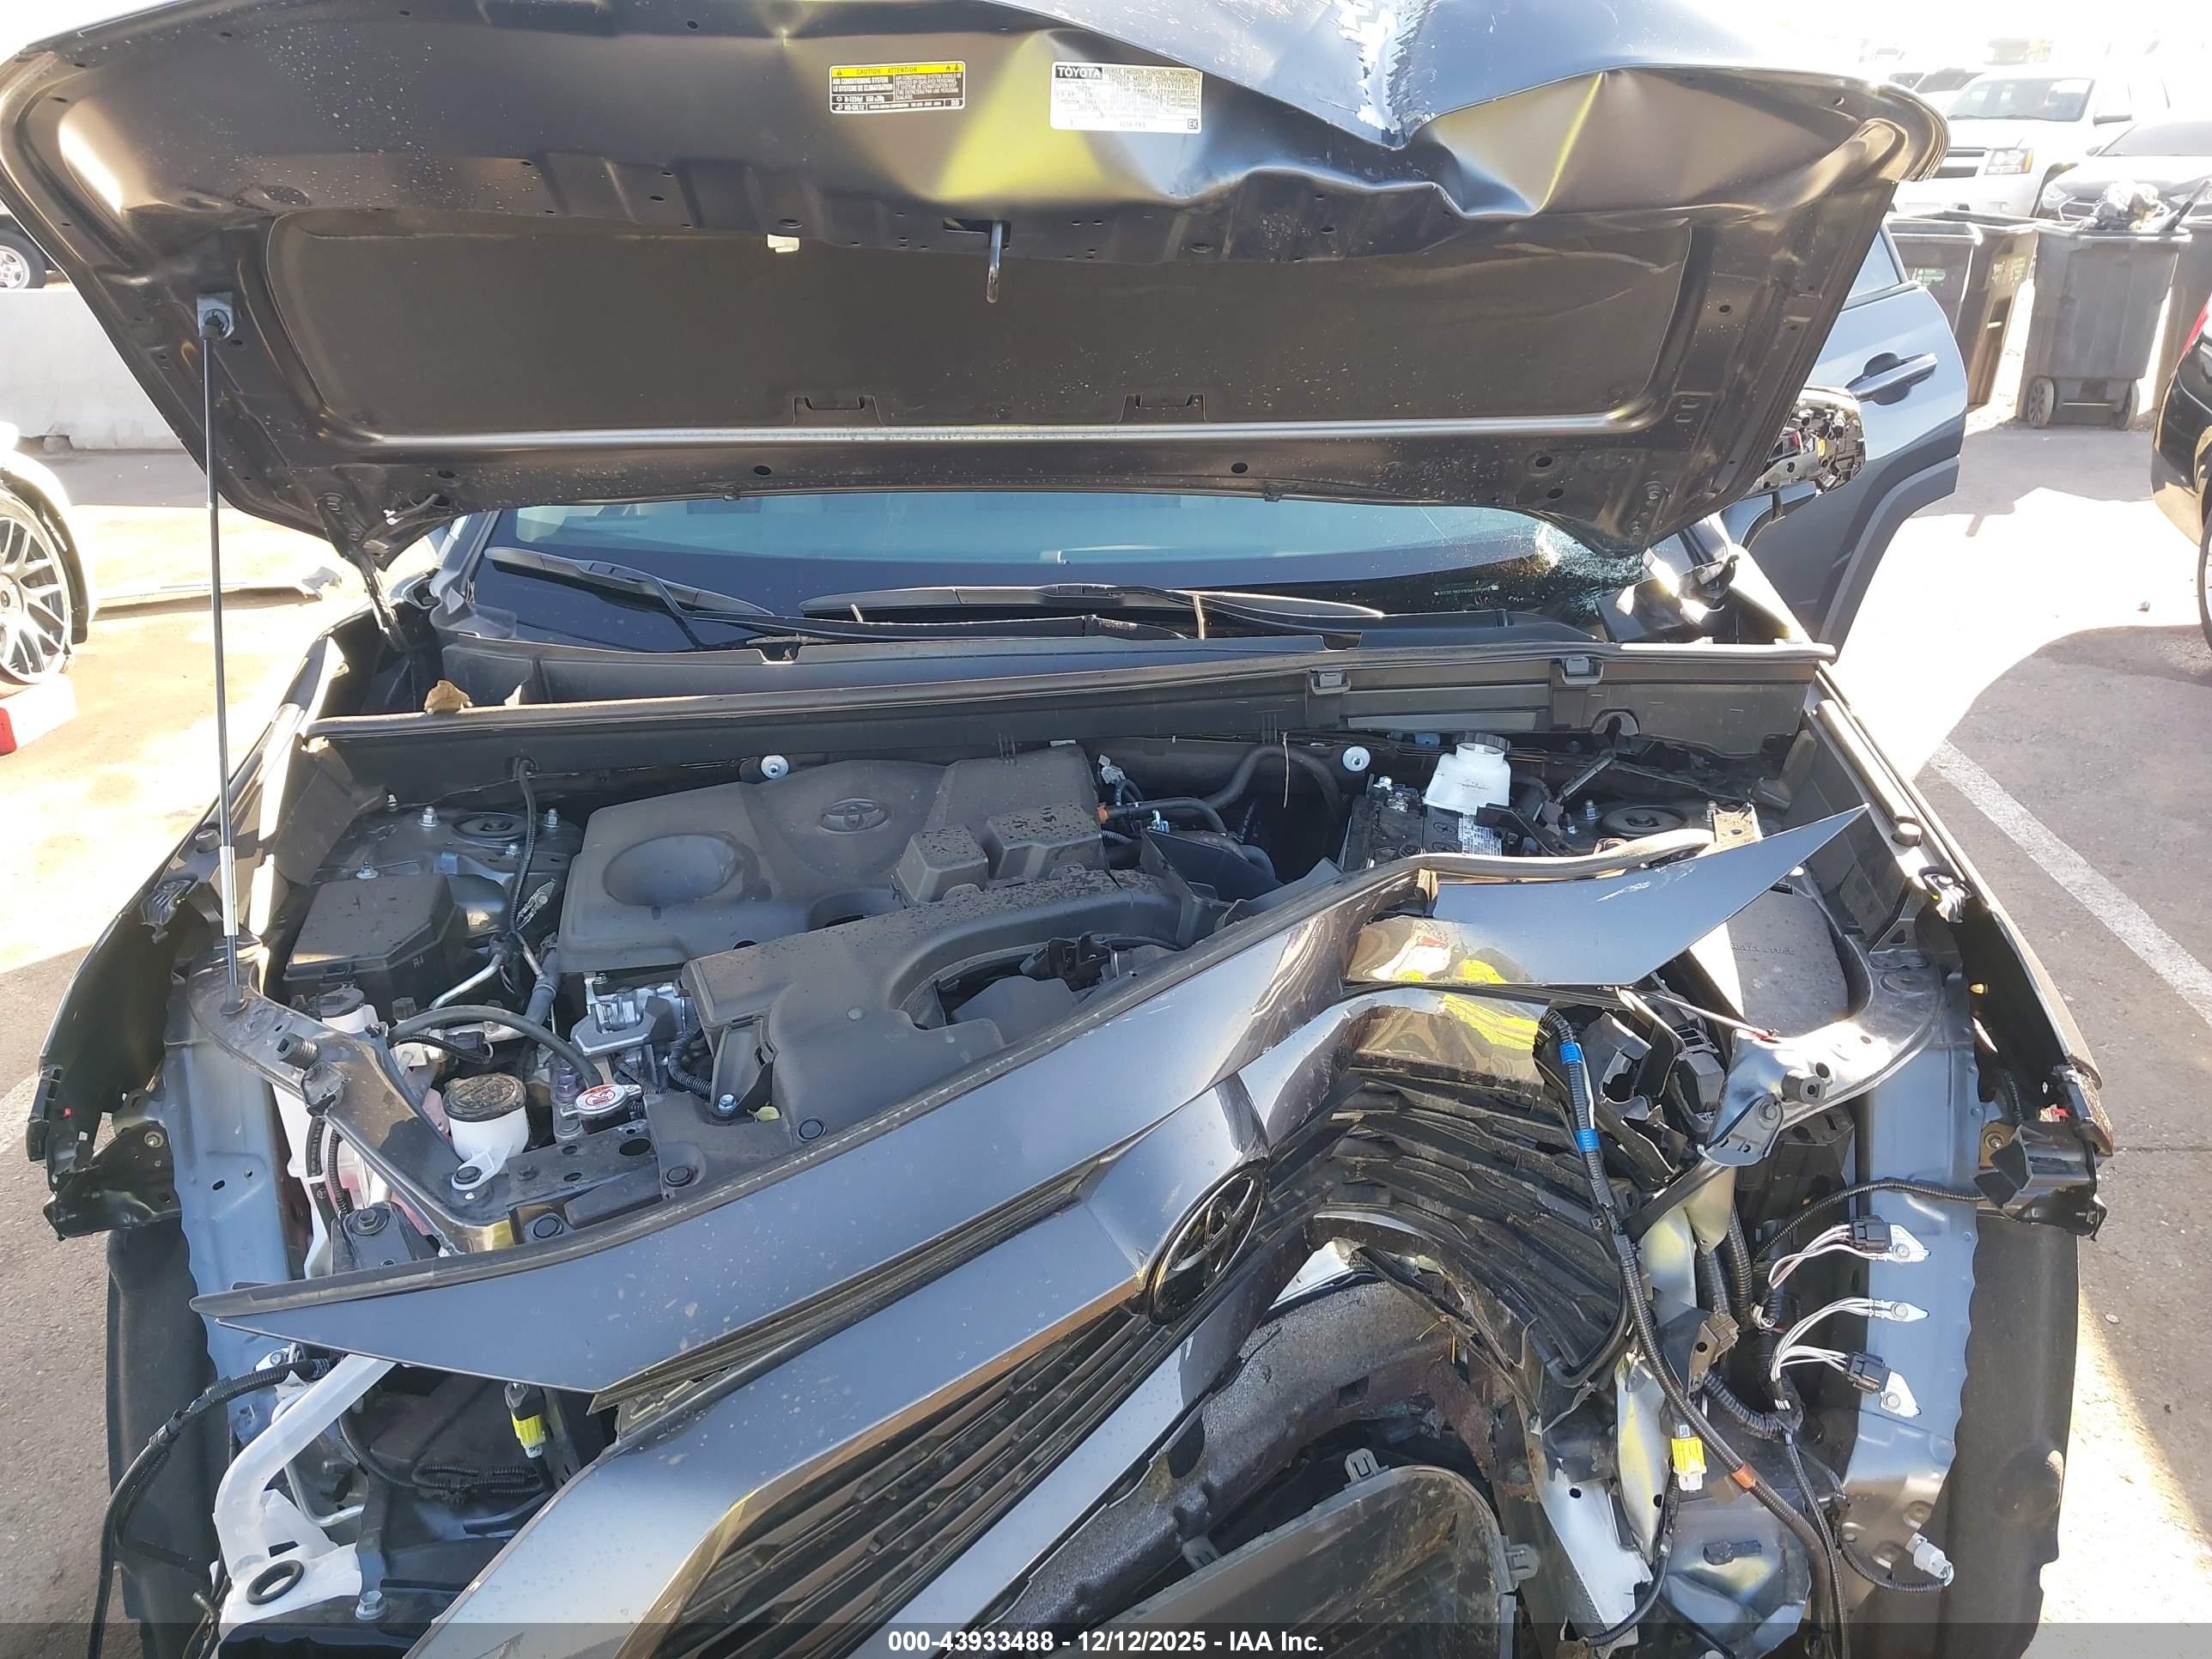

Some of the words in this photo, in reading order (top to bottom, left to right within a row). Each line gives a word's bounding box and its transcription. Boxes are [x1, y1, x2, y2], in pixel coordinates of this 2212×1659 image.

[1058, 66, 1101, 78] TOYOTA
[1188, 119, 1198, 129] EK
[412, 955, 423, 968] R4
